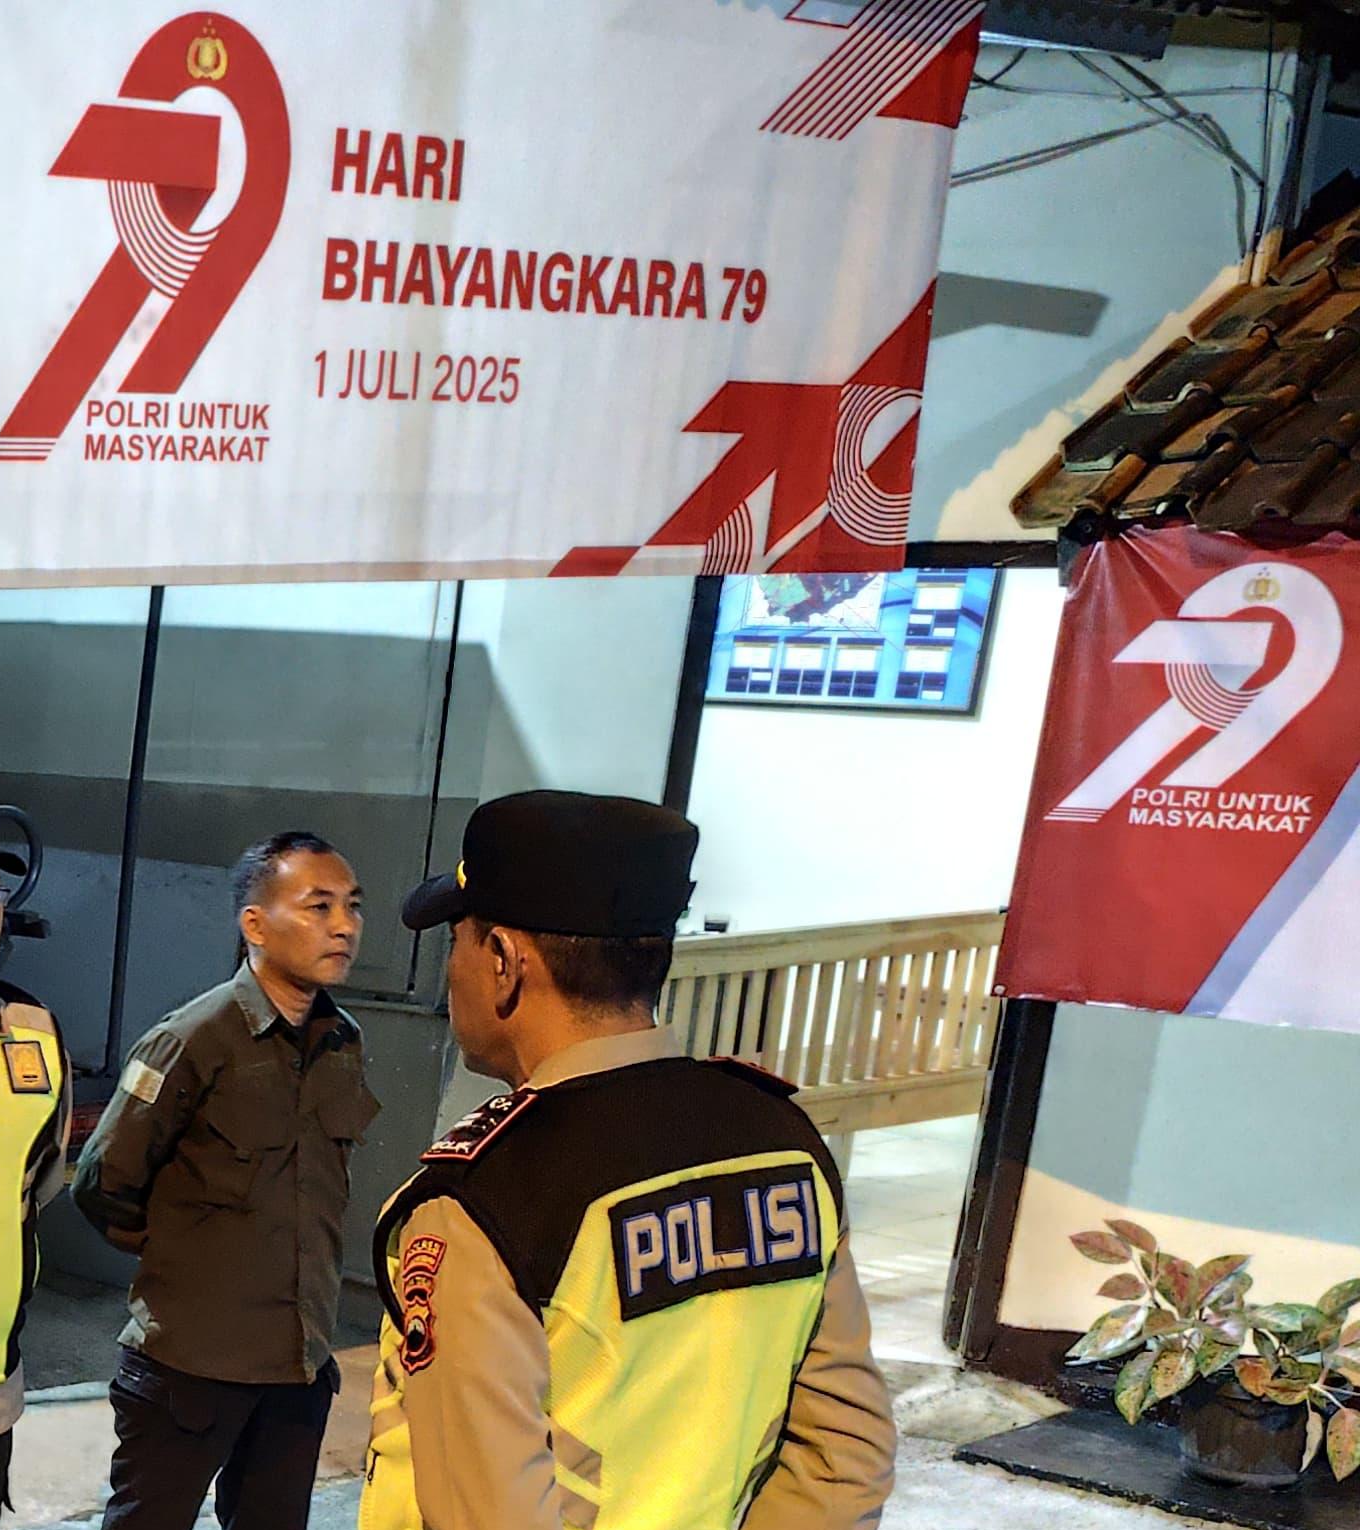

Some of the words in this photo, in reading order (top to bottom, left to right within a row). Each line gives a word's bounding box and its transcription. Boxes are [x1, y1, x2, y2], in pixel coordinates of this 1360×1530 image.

[331, 127, 464, 203] HARI
[321, 238, 705, 321] BHAYANGKARA
[719, 268, 767, 324] 79
[314, 351, 326, 396] 1
[338, 351, 420, 401] JULI
[431, 355, 521, 404] 2025
[86, 400, 169, 429] POLRI
[179, 402, 269, 430] UNTUK
[84, 434, 270, 463] MASYARAKAT
[1128, 807, 1312, 834] MASYARAKAT
[1131, 787, 1210, 808] POLRI
[1217, 792, 1313, 814] UNTUK
[622, 1179, 819, 1297] POLISI
